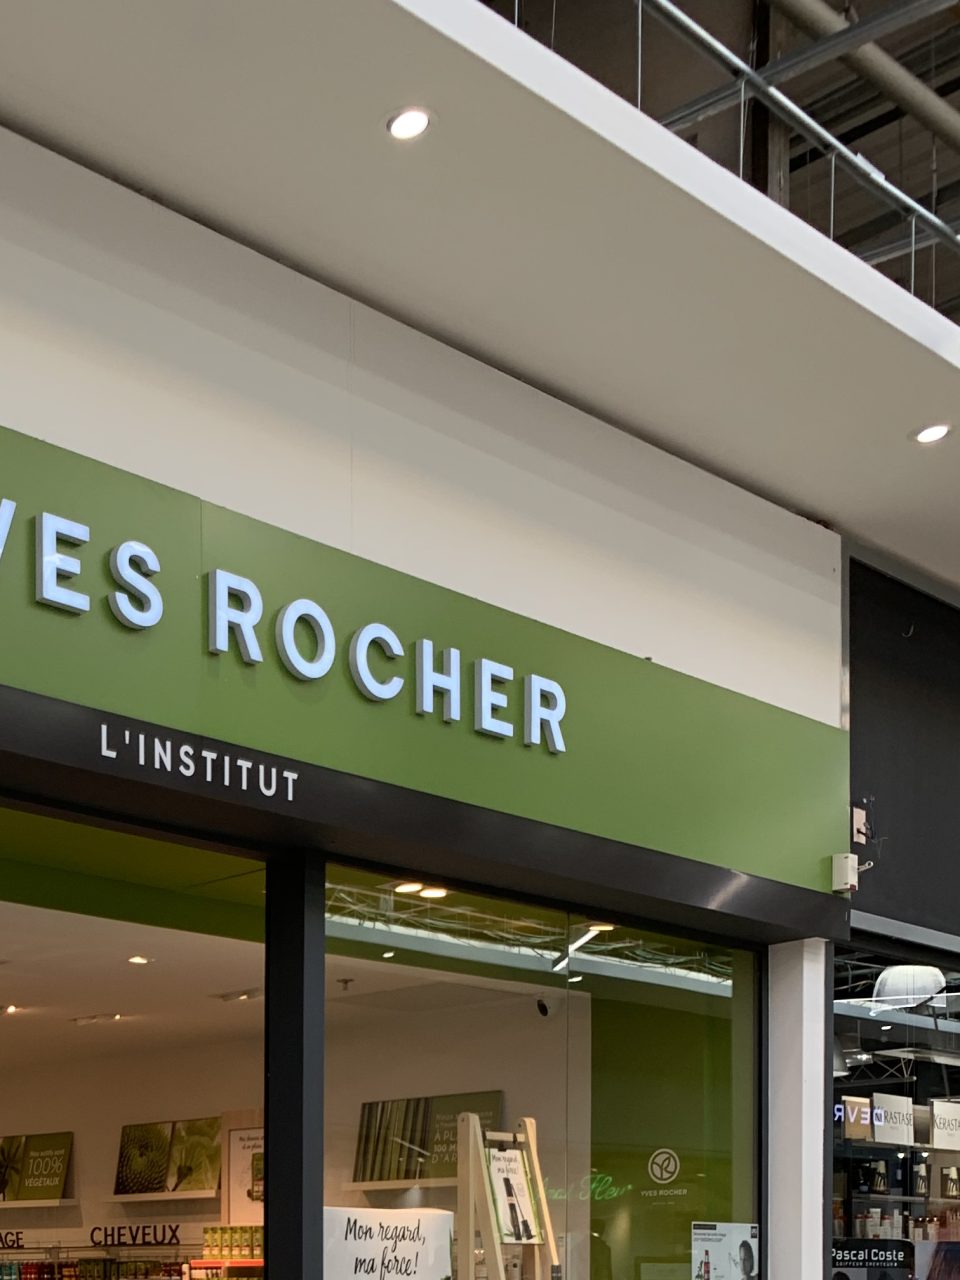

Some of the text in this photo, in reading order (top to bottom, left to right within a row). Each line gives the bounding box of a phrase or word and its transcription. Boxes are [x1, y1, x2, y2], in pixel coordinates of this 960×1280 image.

[206, 567, 568, 754] ROCHER
[100, 723, 299, 801] L'INSTITUT
[28, 1156, 64, 1175] 100%
[658, 1188, 688, 1197] ROCHER
[90, 1224, 180, 1247] CHEVEUX
[344, 1217, 426, 1253] Mon regard,
[871, 1248, 905, 1261] Coste
[354, 1256, 377, 1275] ma
